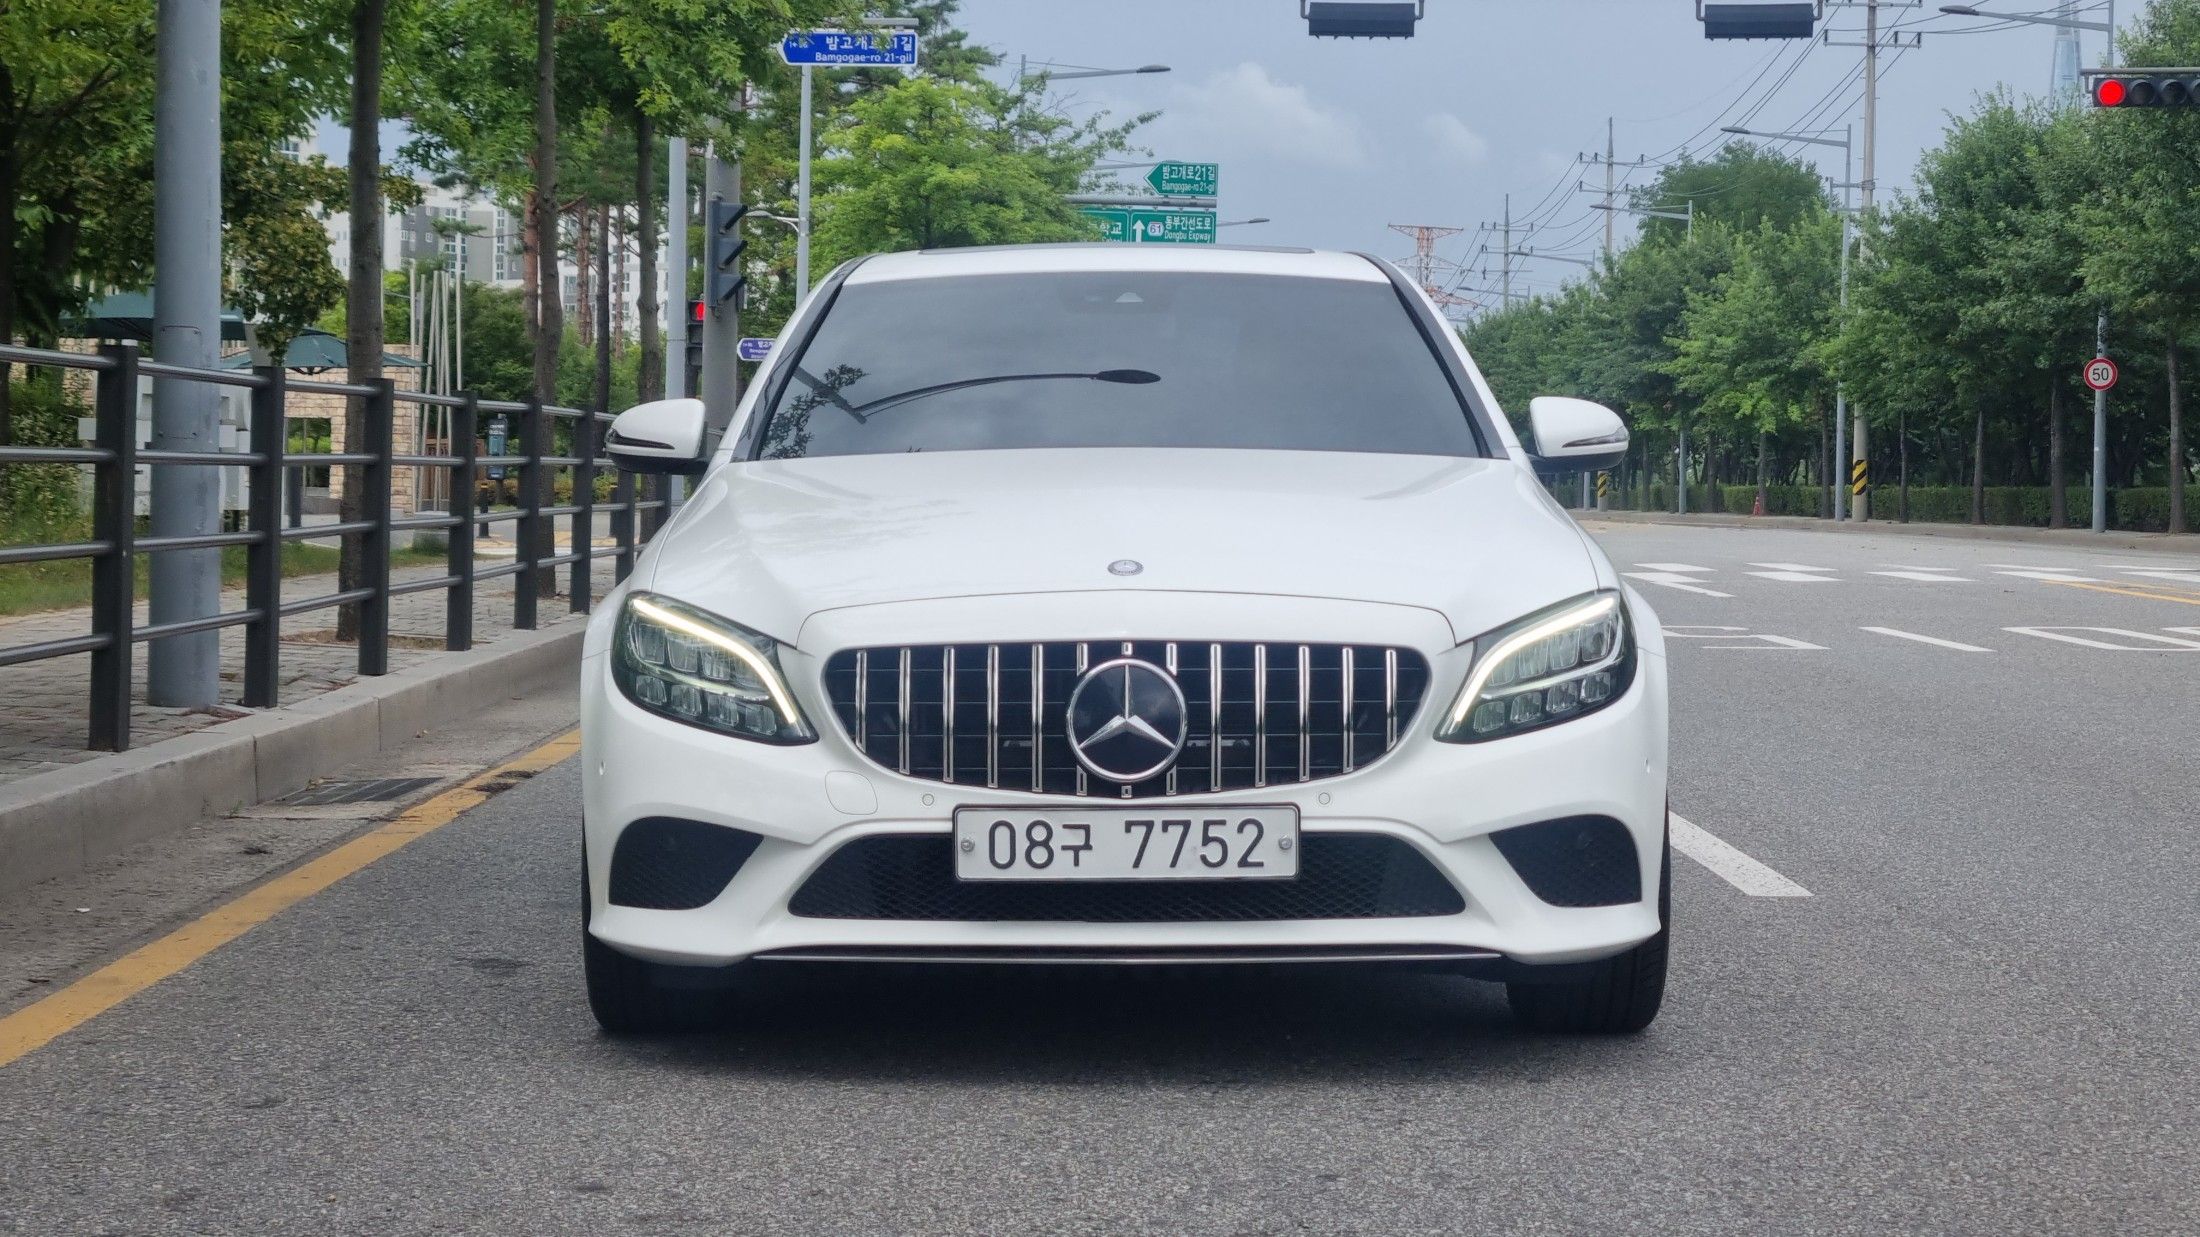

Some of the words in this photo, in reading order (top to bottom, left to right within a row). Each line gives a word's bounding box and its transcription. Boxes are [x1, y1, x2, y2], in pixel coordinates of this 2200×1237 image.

[815, 52, 880, 63] Bamgogae-ro
[884, 52, 912, 63] 21-gil
[1162, 165, 1215, 181] 밤고개로21길
[1162, 181, 1199, 193] Bamgogae-ro
[1199, 182, 1216, 194] 21-gil
[1149, 224, 1162, 234] 61
[1165, 215, 1212, 231] 동부간선도로
[1164, 230, 1187, 242] Dongbu
[1188, 231, 1212, 244] Expway
[2092, 367, 2109, 381] 50
[988, 820, 1093, 869] 08구
[1124, 818, 1264, 869] 7752
